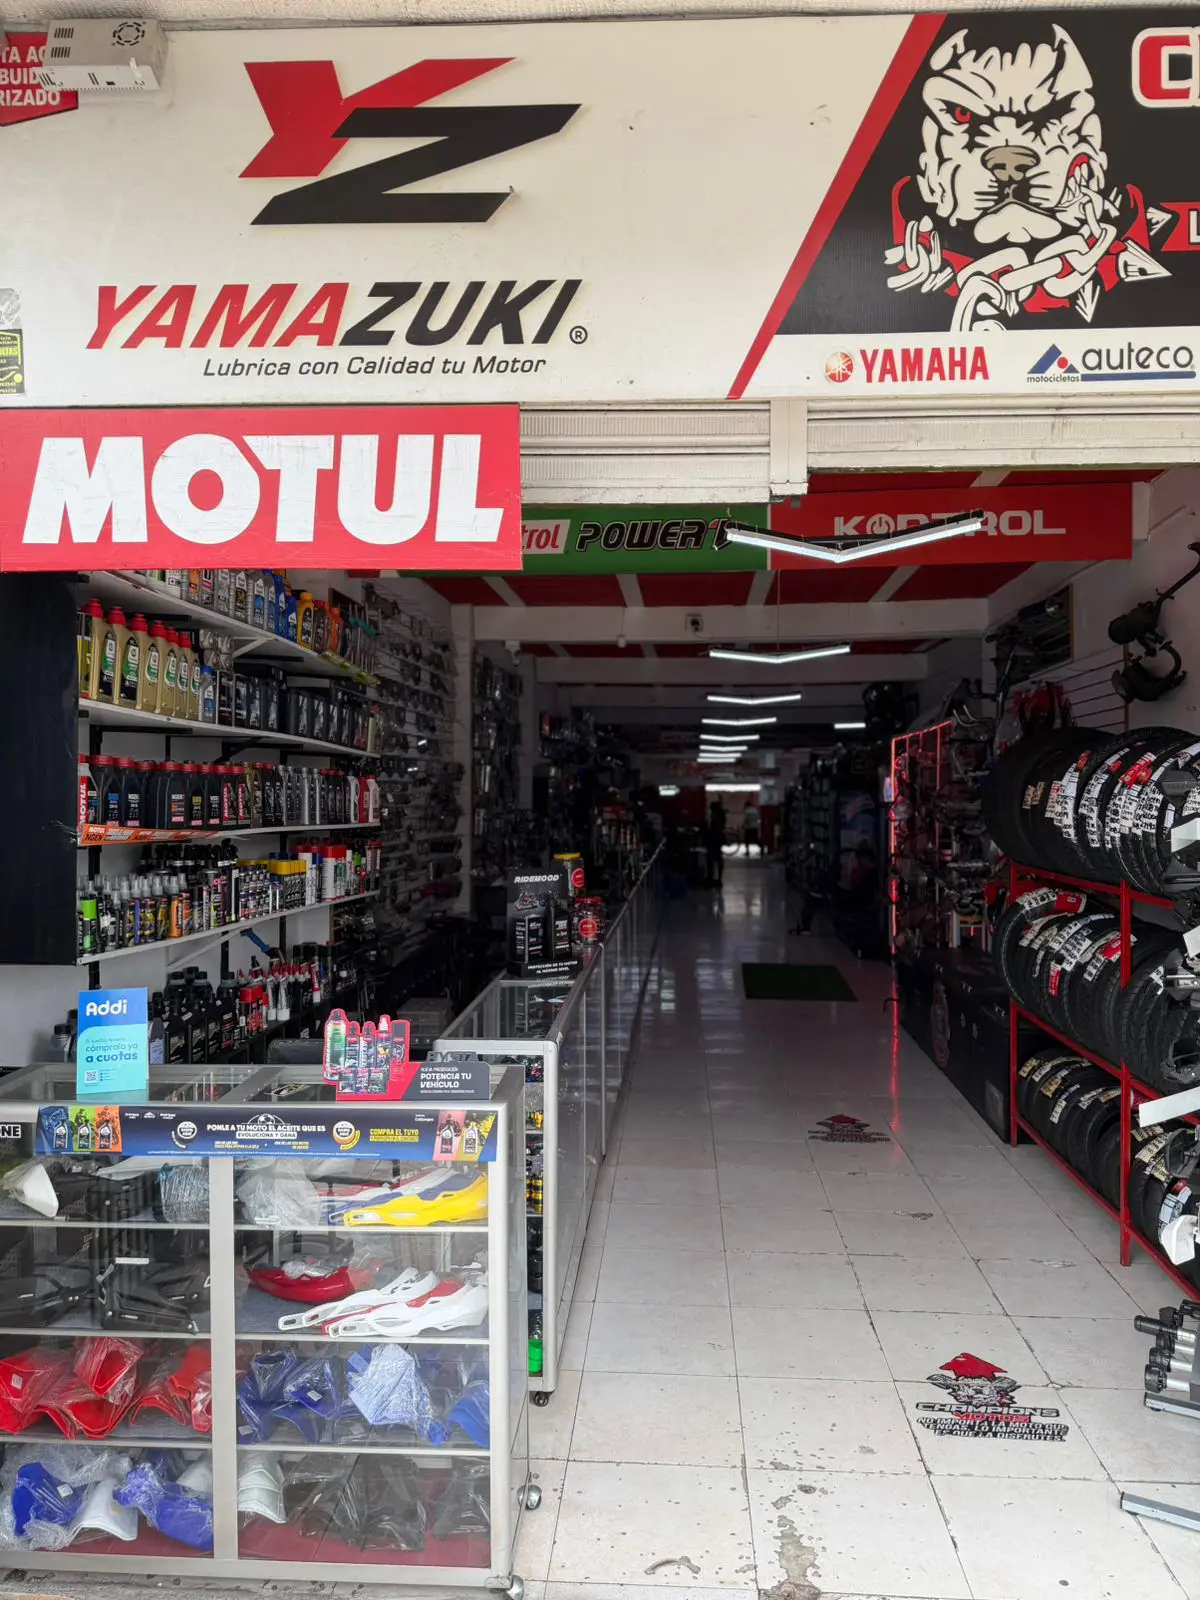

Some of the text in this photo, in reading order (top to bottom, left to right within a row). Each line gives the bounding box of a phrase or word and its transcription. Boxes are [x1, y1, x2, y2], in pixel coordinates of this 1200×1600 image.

[86, 279, 584, 349] YAMAZUKI
[859, 346, 989, 383] YAMAHA
[1082, 342, 1193, 370] auteco
[203, 356, 547, 377] Lubrica con Calidad tu Motor
[1027, 373, 1080, 383] motocicletas
[22, 433, 504, 544] MOTUL
[514, 874, 559, 884] RIDEMOOD
[86, 999, 128, 1017] Addi
[86, 1051, 138, 1063] a cuotas
[370, 1128, 394, 1136] COMPRA
[916, 1402, 1060, 1418] CHAMPIONS
